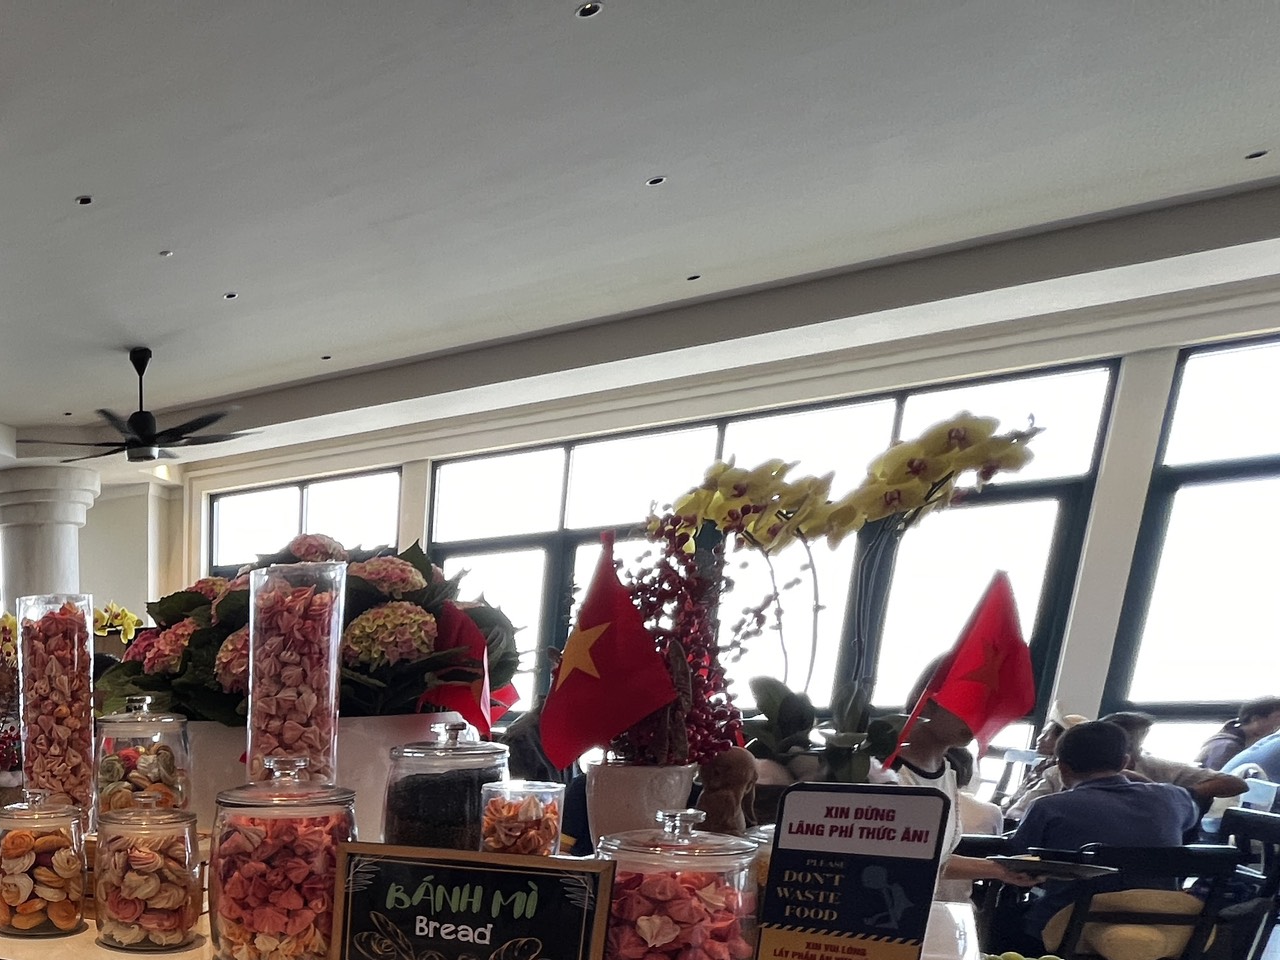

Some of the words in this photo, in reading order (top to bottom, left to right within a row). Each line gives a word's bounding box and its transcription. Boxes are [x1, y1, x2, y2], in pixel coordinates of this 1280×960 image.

[824, 806, 850, 820] XIN
[854, 805, 896, 821] ĐỪNG
[788, 820, 825, 836] LÃNG
[828, 823, 854, 838] PHÍ
[858, 824, 897, 841] THỨC
[900, 826, 930, 843] ĂN!
[783, 870, 845, 886] DON'T
[385, 875, 483, 916] BÁNH
[490, 881, 539, 919] MÌ
[776, 887, 842, 905] WASTE
[785, 905, 838, 921] FOOD
[415, 915, 494, 945] Bread
